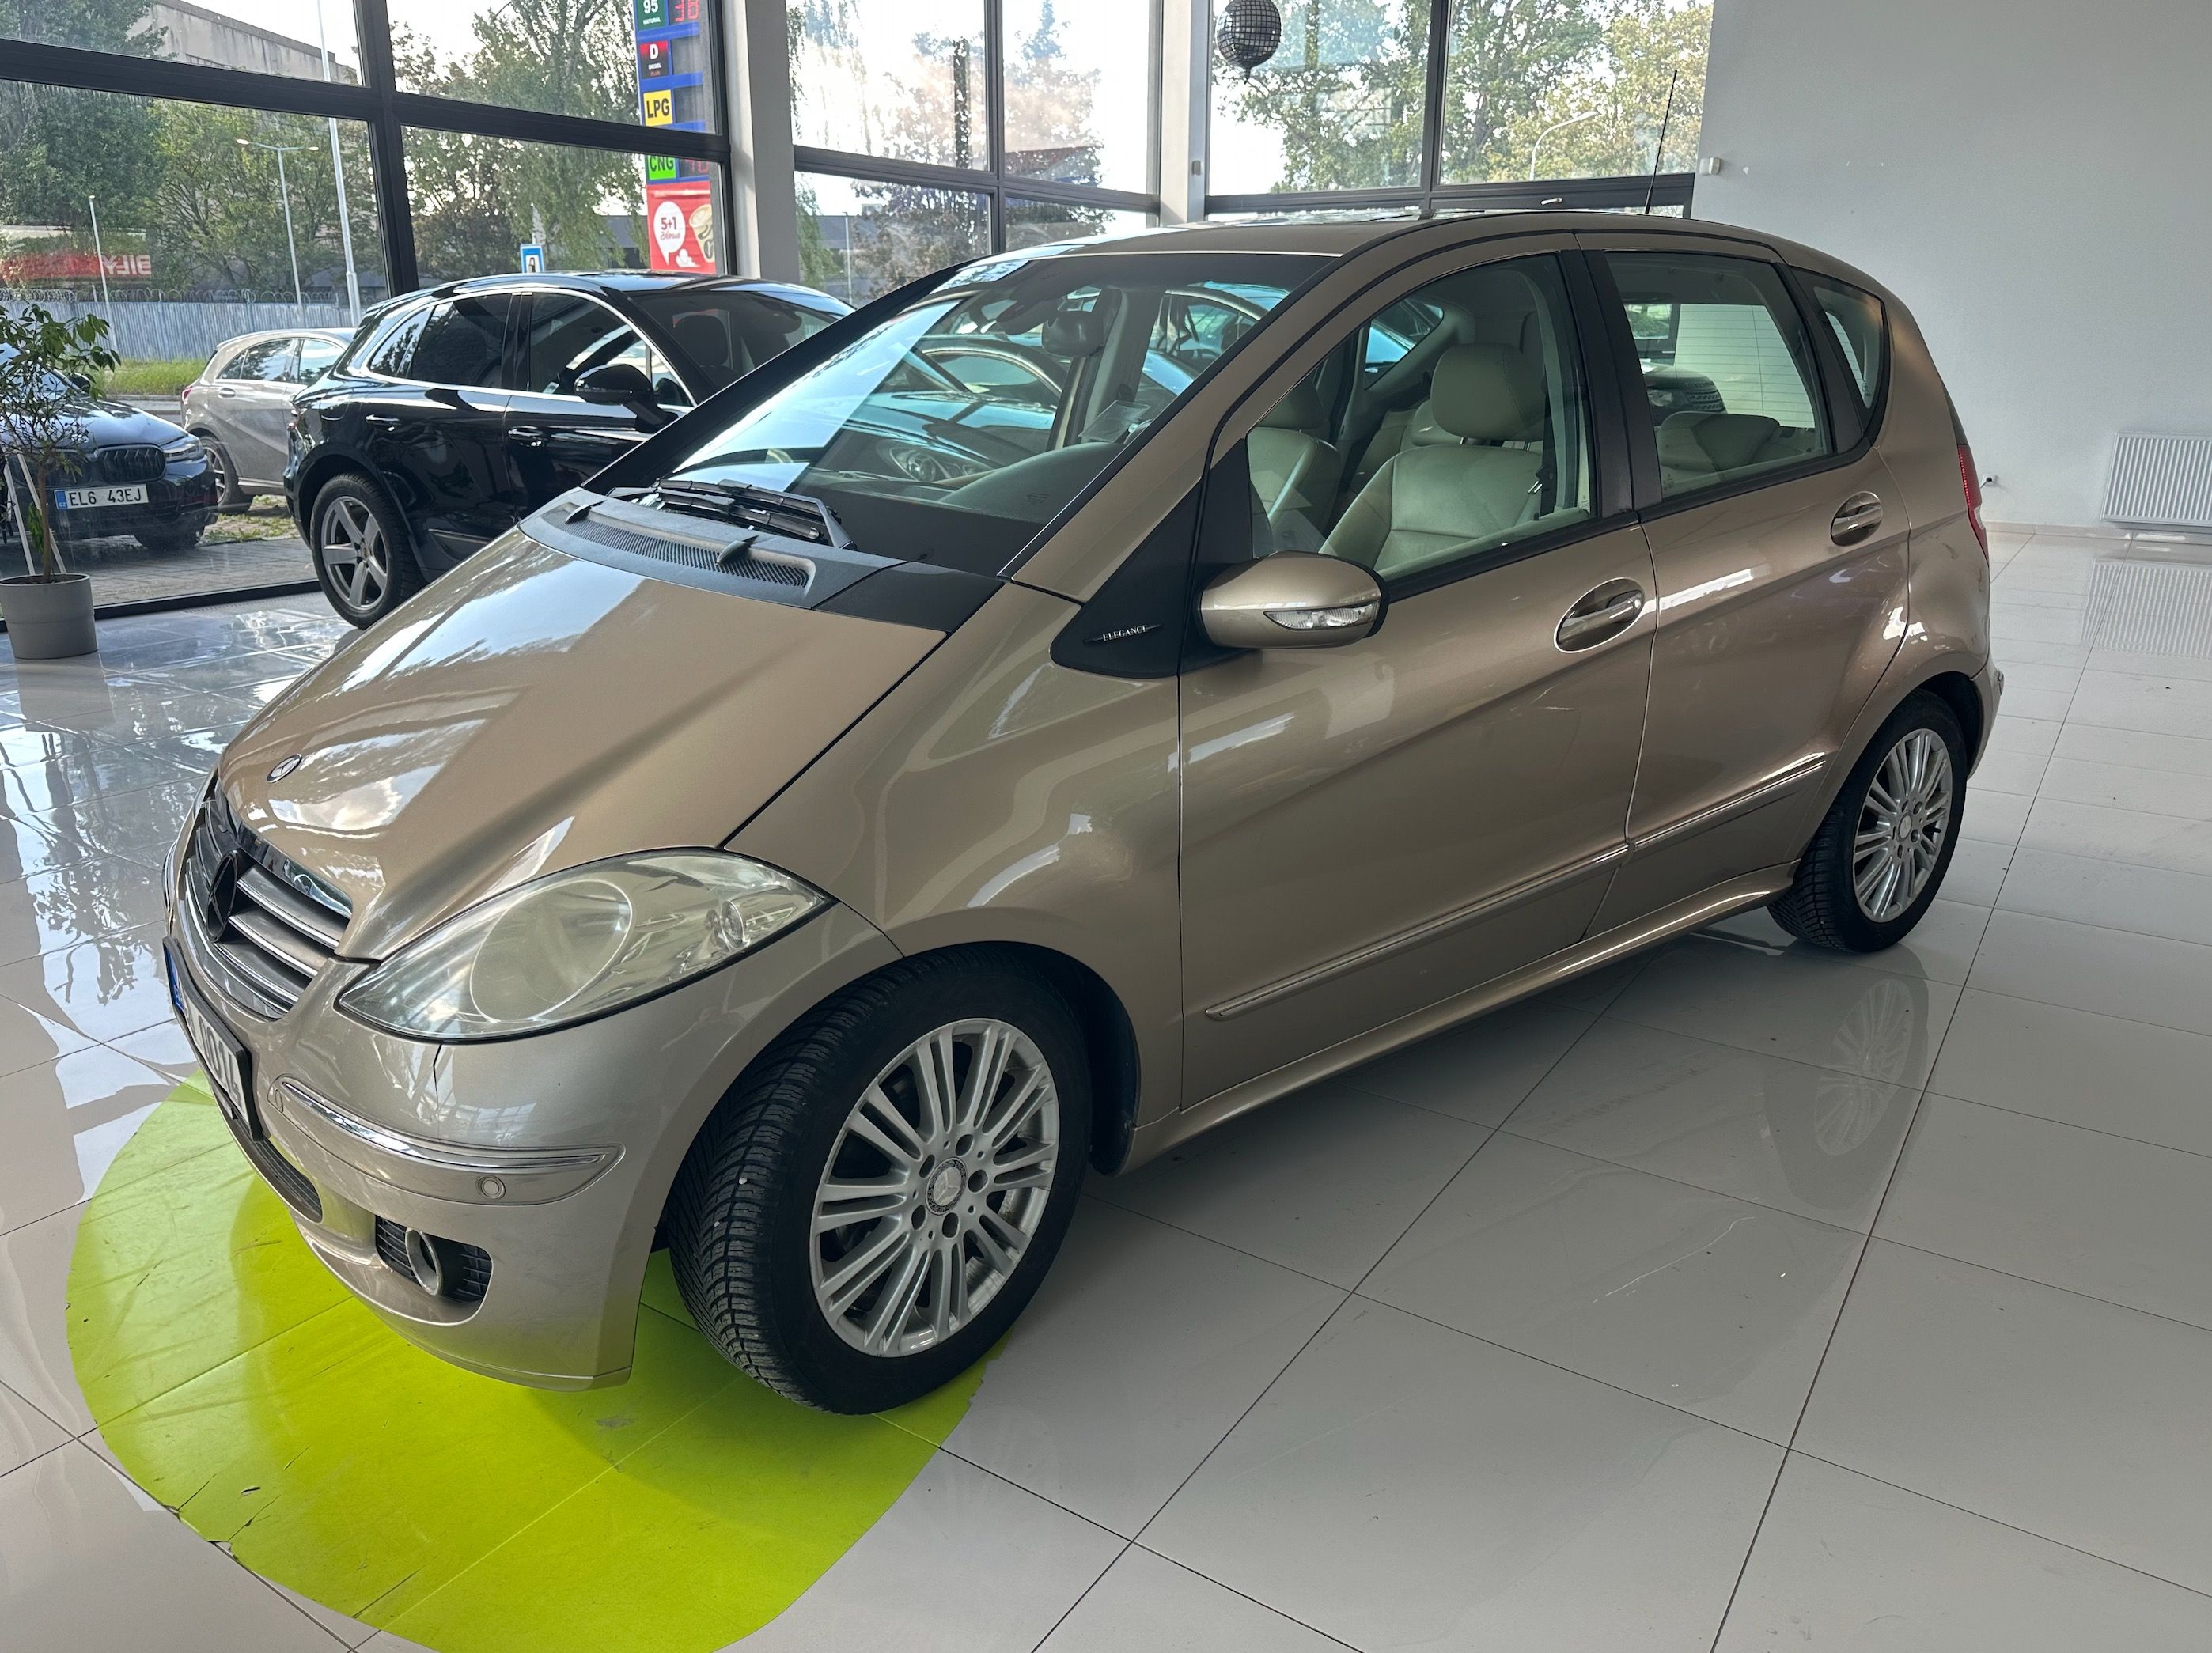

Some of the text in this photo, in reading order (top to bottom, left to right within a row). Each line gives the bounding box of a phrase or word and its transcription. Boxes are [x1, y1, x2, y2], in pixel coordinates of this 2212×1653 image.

[643, 0, 659, 13] 95
[650, 44, 659, 59] D
[646, 99, 670, 118] LPG
[650, 156, 674, 171] CNG
[661, 218, 677, 230] 5+1
[69, 487, 142, 506] EL6 43EJ
[1103, 625, 1147, 641] ELEGANCE
